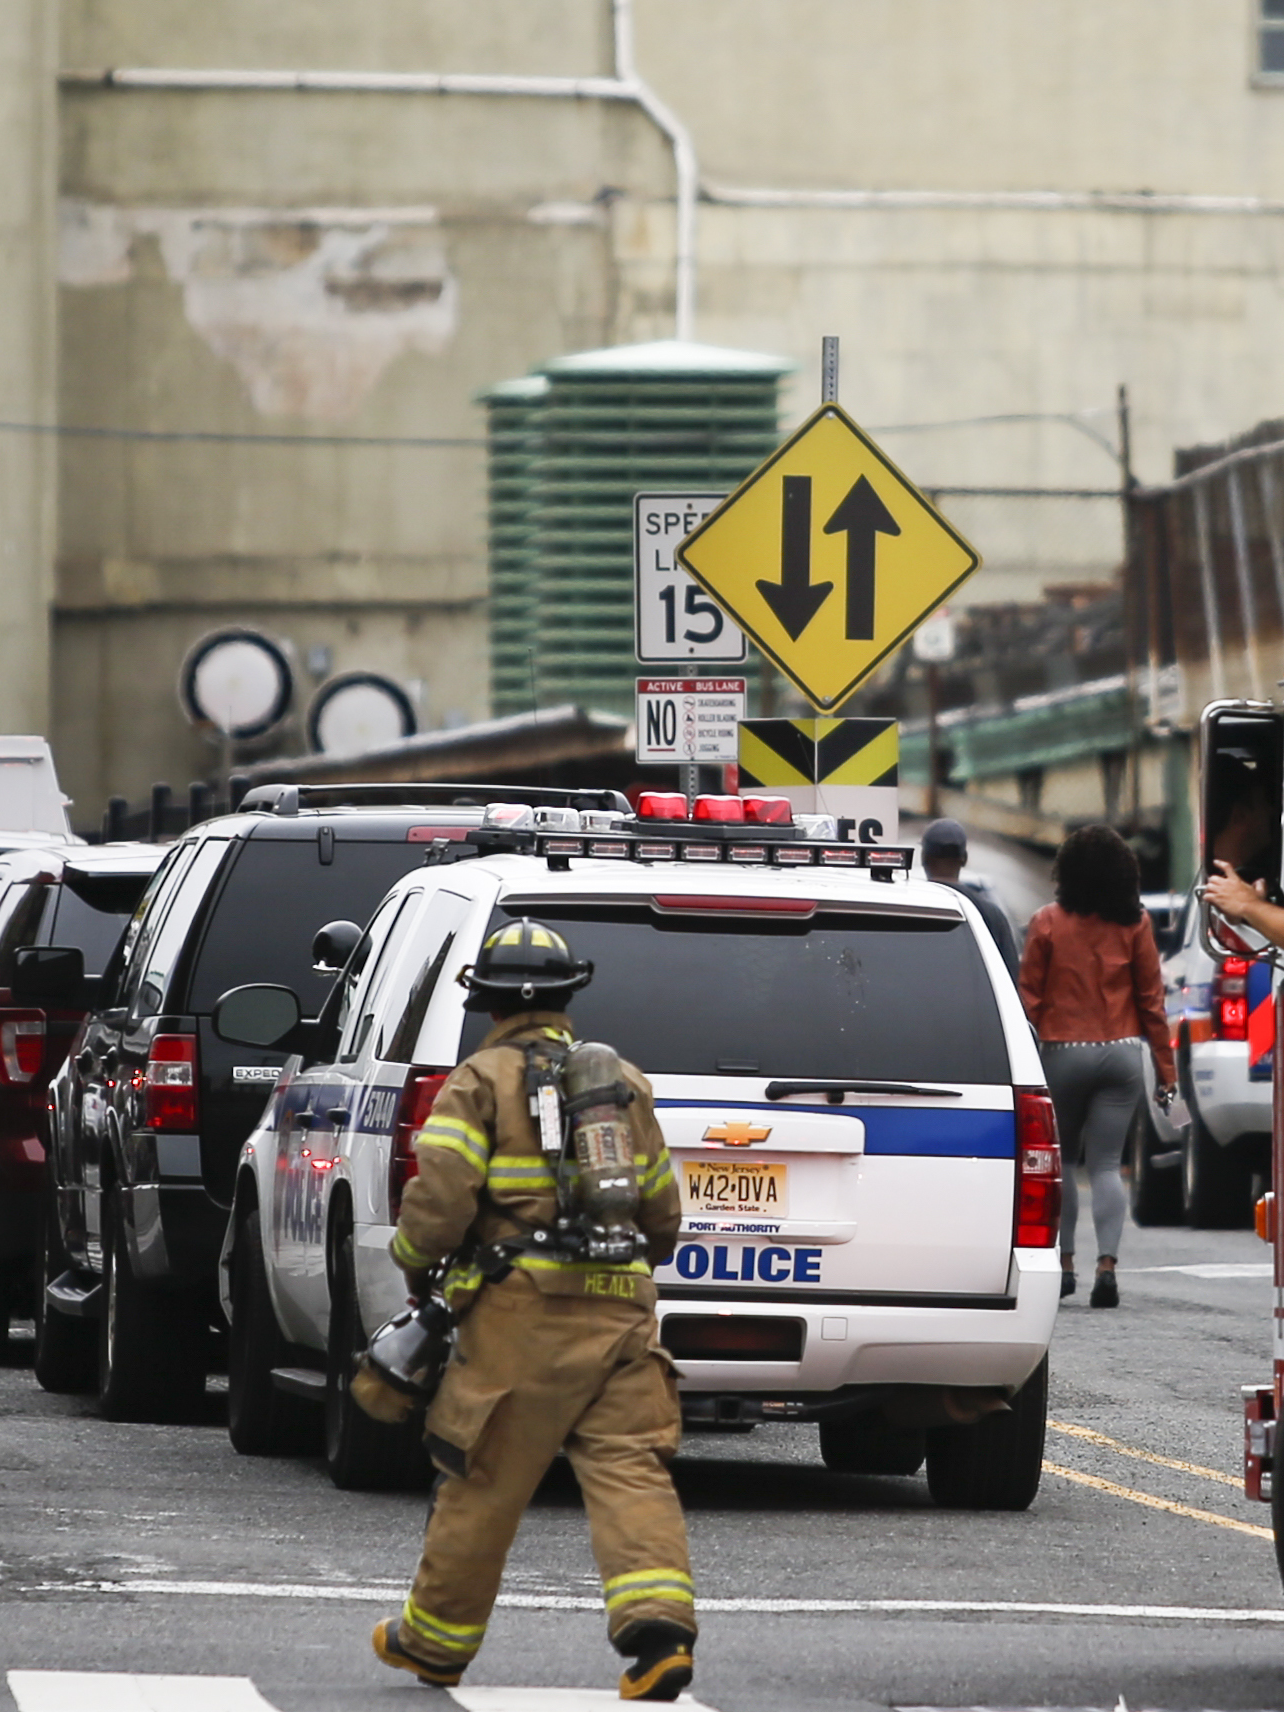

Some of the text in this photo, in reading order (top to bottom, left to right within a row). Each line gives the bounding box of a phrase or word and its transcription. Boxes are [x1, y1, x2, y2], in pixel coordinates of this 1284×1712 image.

[645, 512, 710, 536] SPE
[659, 585, 724, 643] 15
[646, 681, 740, 691] ACTIVE BUS LANE
[647, 699, 676, 746] NO
[706, 1163, 761, 1174] New Jersey
[705, 1203, 760, 1212] Garden State
[688, 1222, 781, 1233] PORT AUTHORITY
[658, 1243, 823, 1283] OLICE
[584, 1272, 636, 1298] HEALY
